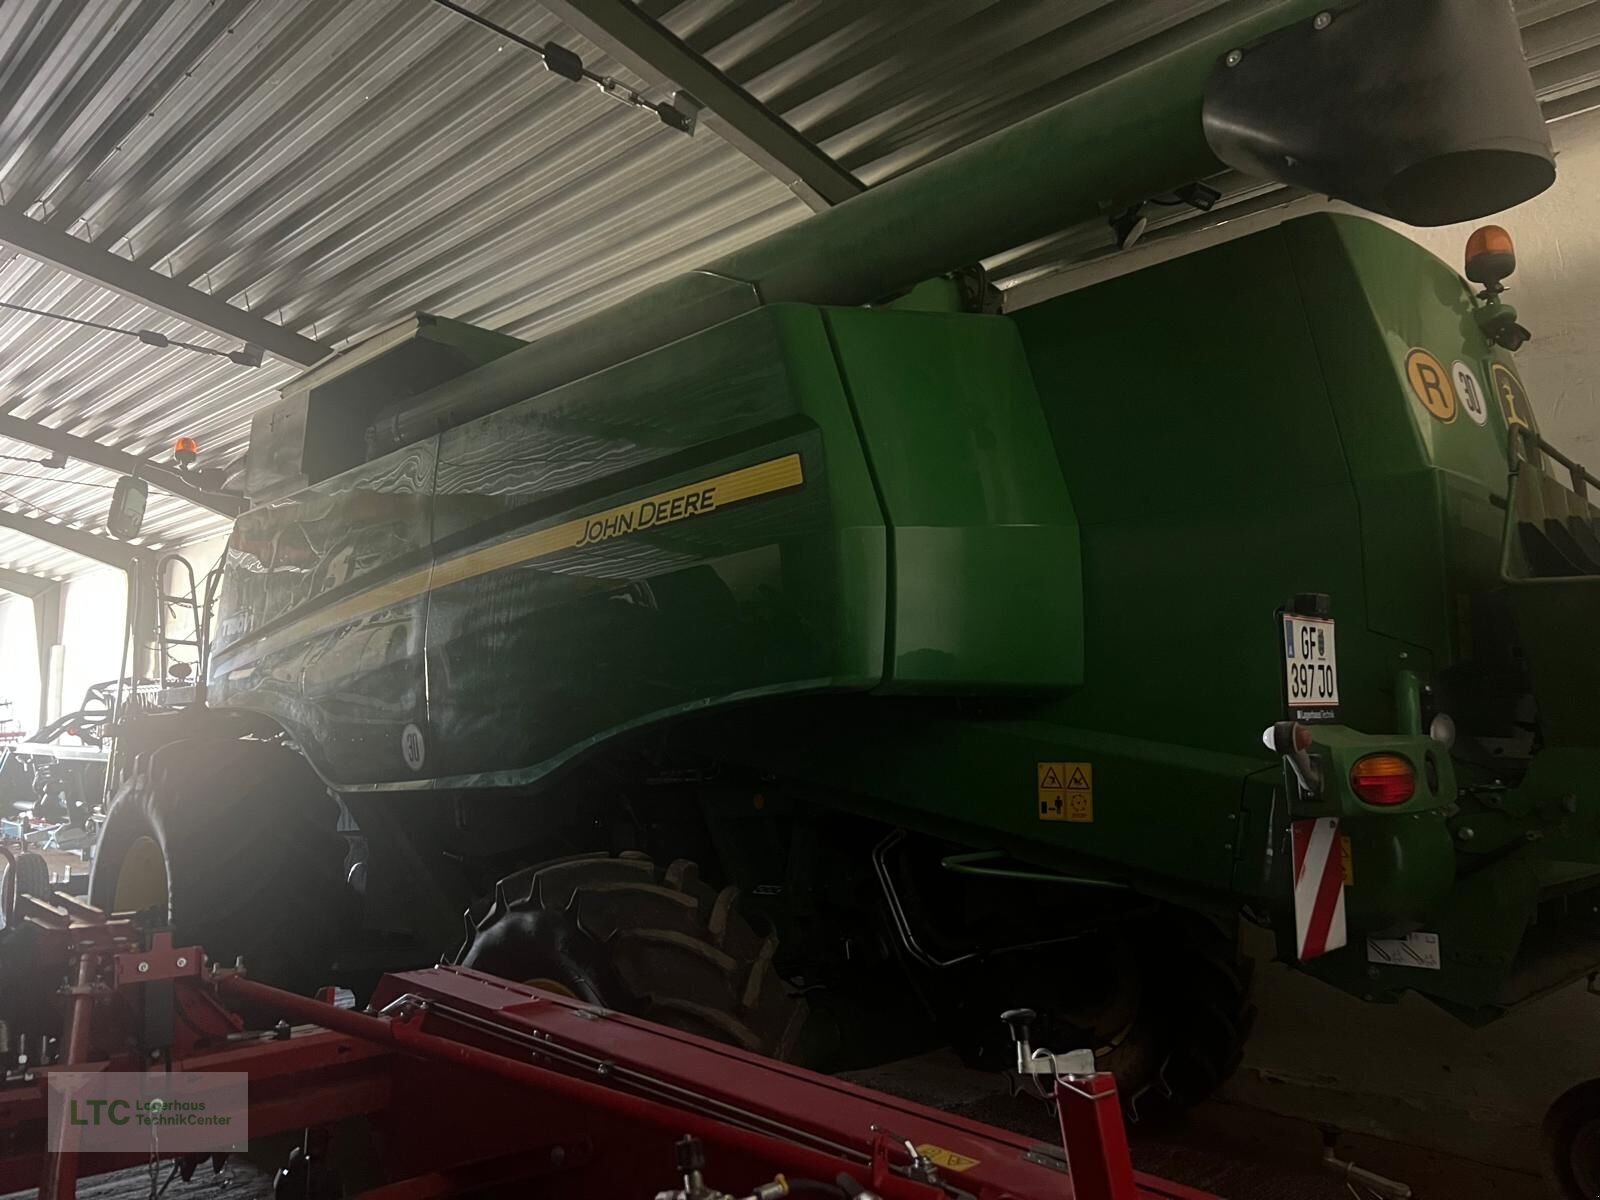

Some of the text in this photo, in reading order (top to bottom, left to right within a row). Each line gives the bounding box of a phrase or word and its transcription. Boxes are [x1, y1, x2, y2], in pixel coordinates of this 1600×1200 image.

[1416, 363, 1449, 409] R
[1458, 371, 1482, 415] 30
[576, 487, 717, 545] JOHN DEERE
[1301, 626, 1316, 660] GF
[1292, 663, 1314, 698] 397
[407, 733, 420, 762] 30
